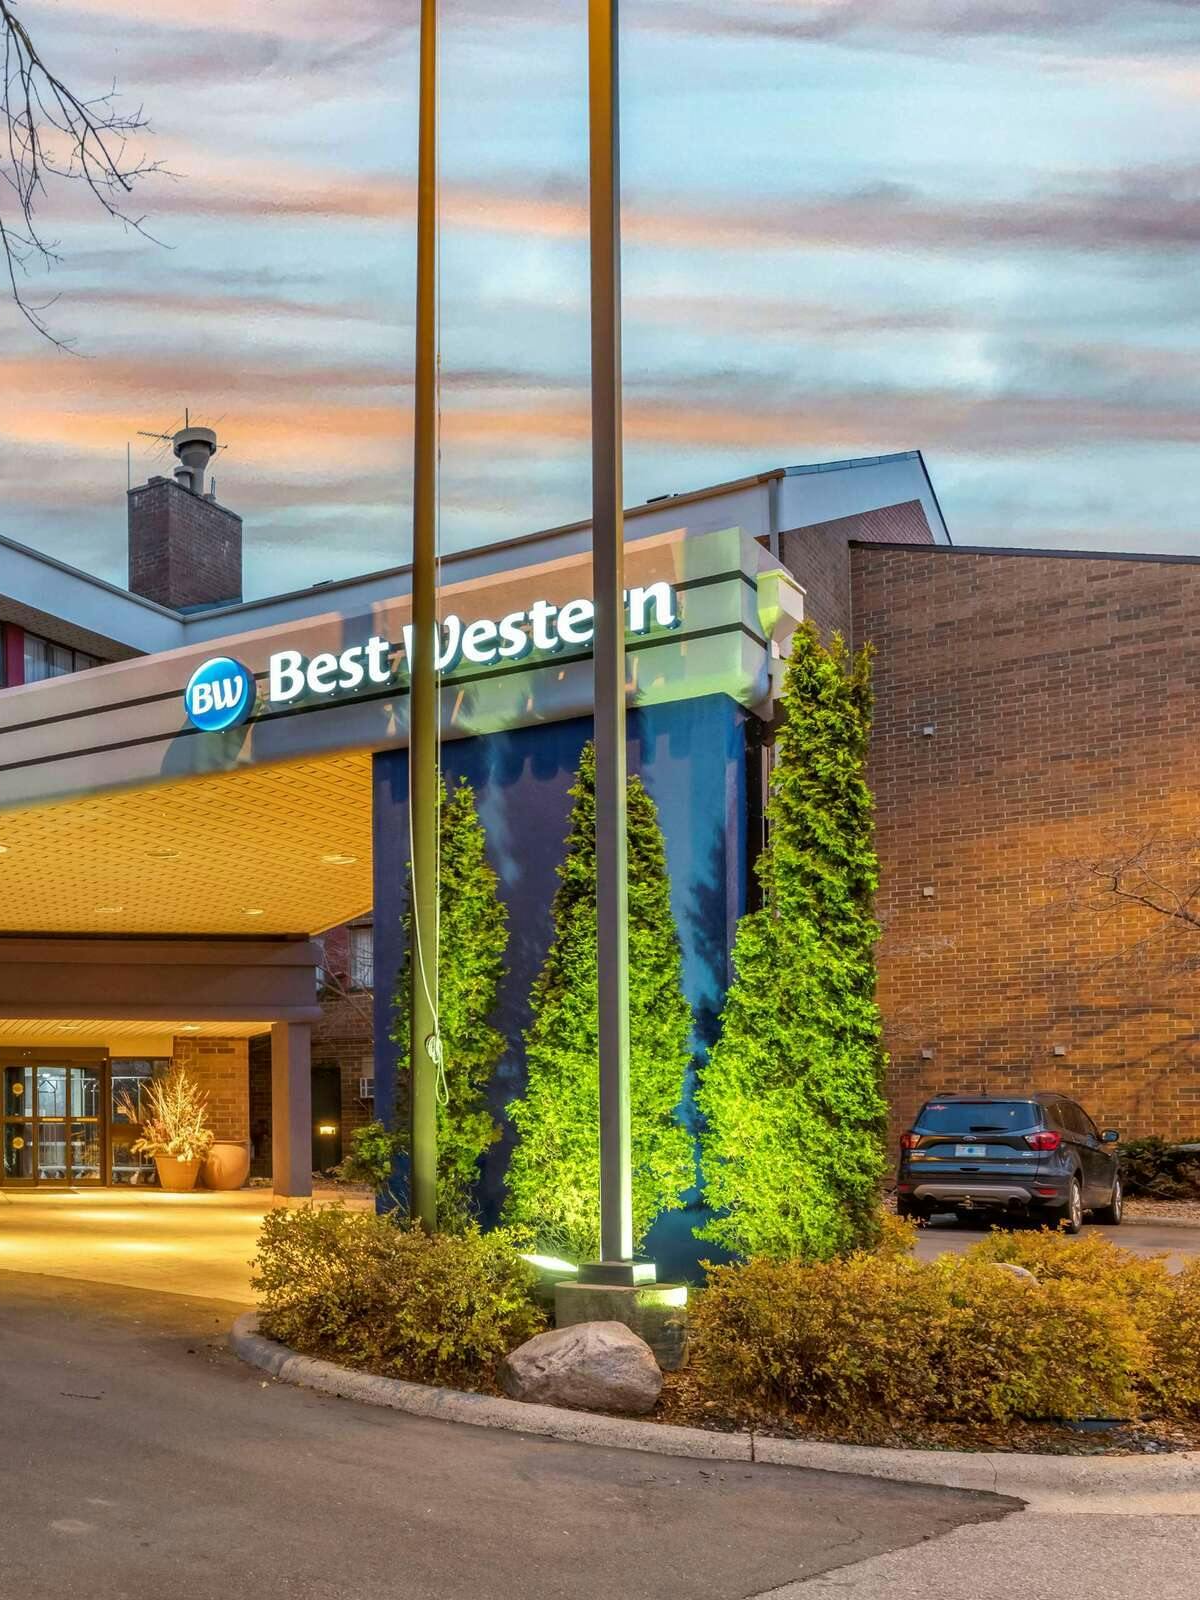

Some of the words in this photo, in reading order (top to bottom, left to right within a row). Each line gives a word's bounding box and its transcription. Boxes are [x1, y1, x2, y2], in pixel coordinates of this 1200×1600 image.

[270, 636, 390, 701] Best
[403, 581, 675, 674] Westen
[192, 675, 243, 715] BW
